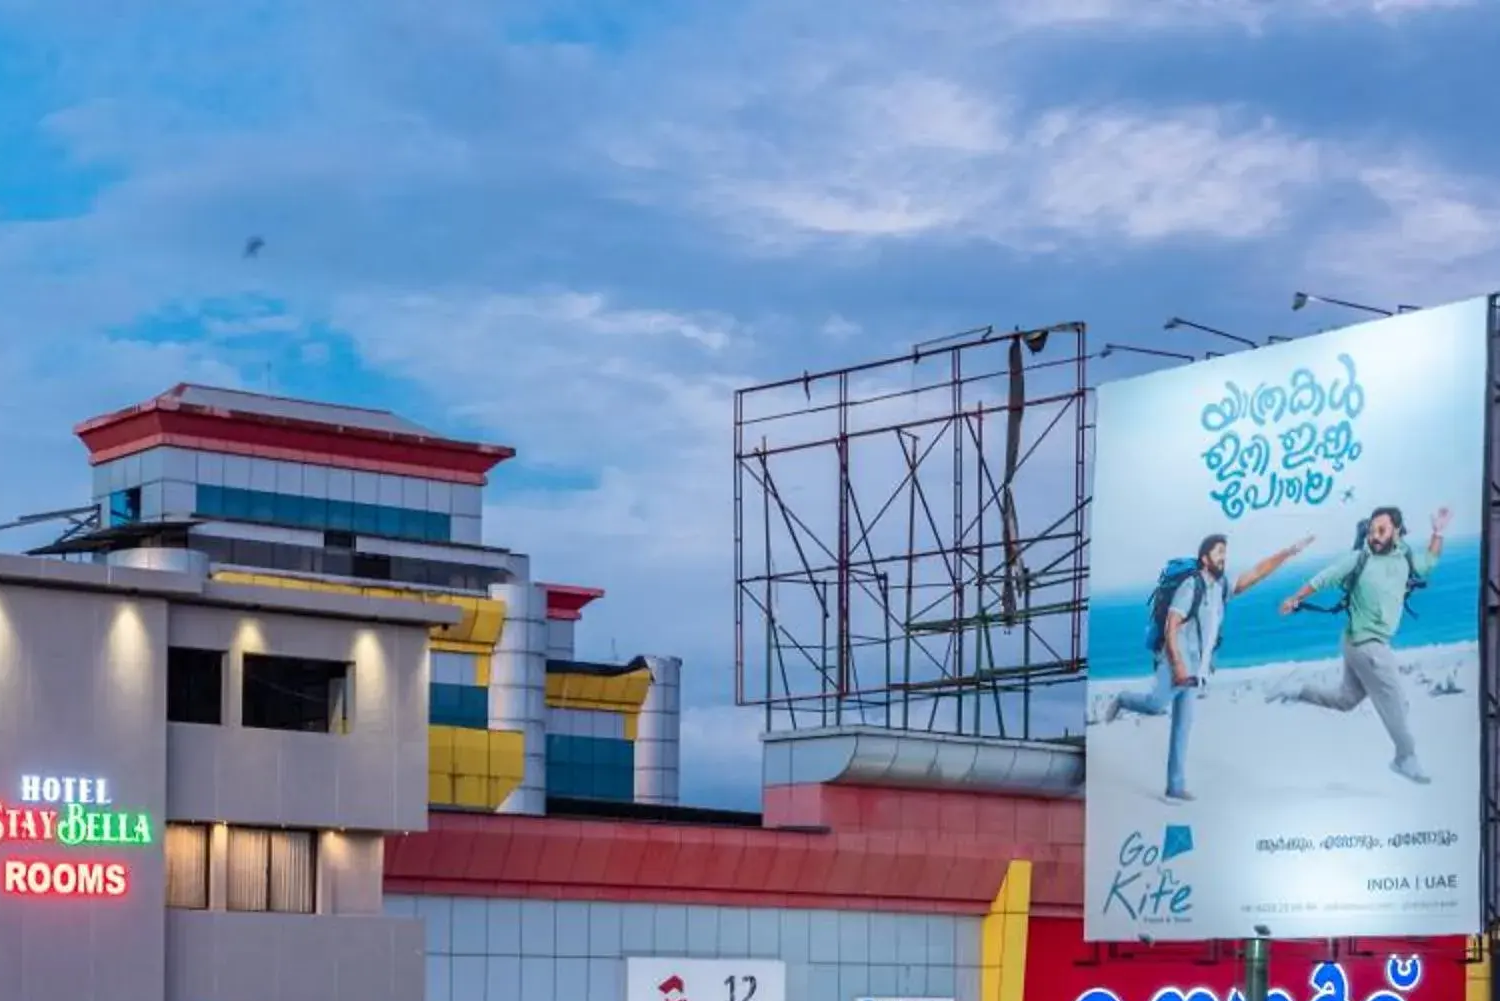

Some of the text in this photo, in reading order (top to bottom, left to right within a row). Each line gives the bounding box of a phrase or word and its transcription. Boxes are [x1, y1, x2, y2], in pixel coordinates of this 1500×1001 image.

[21, 774, 112, 804] HOTEL
[1119, 832, 1159, 867] Go
[4, 860, 127, 895] ROOMS
[1103, 868, 1193, 920] Kite
[1367, 874, 1458, 891] INDIA UAE
